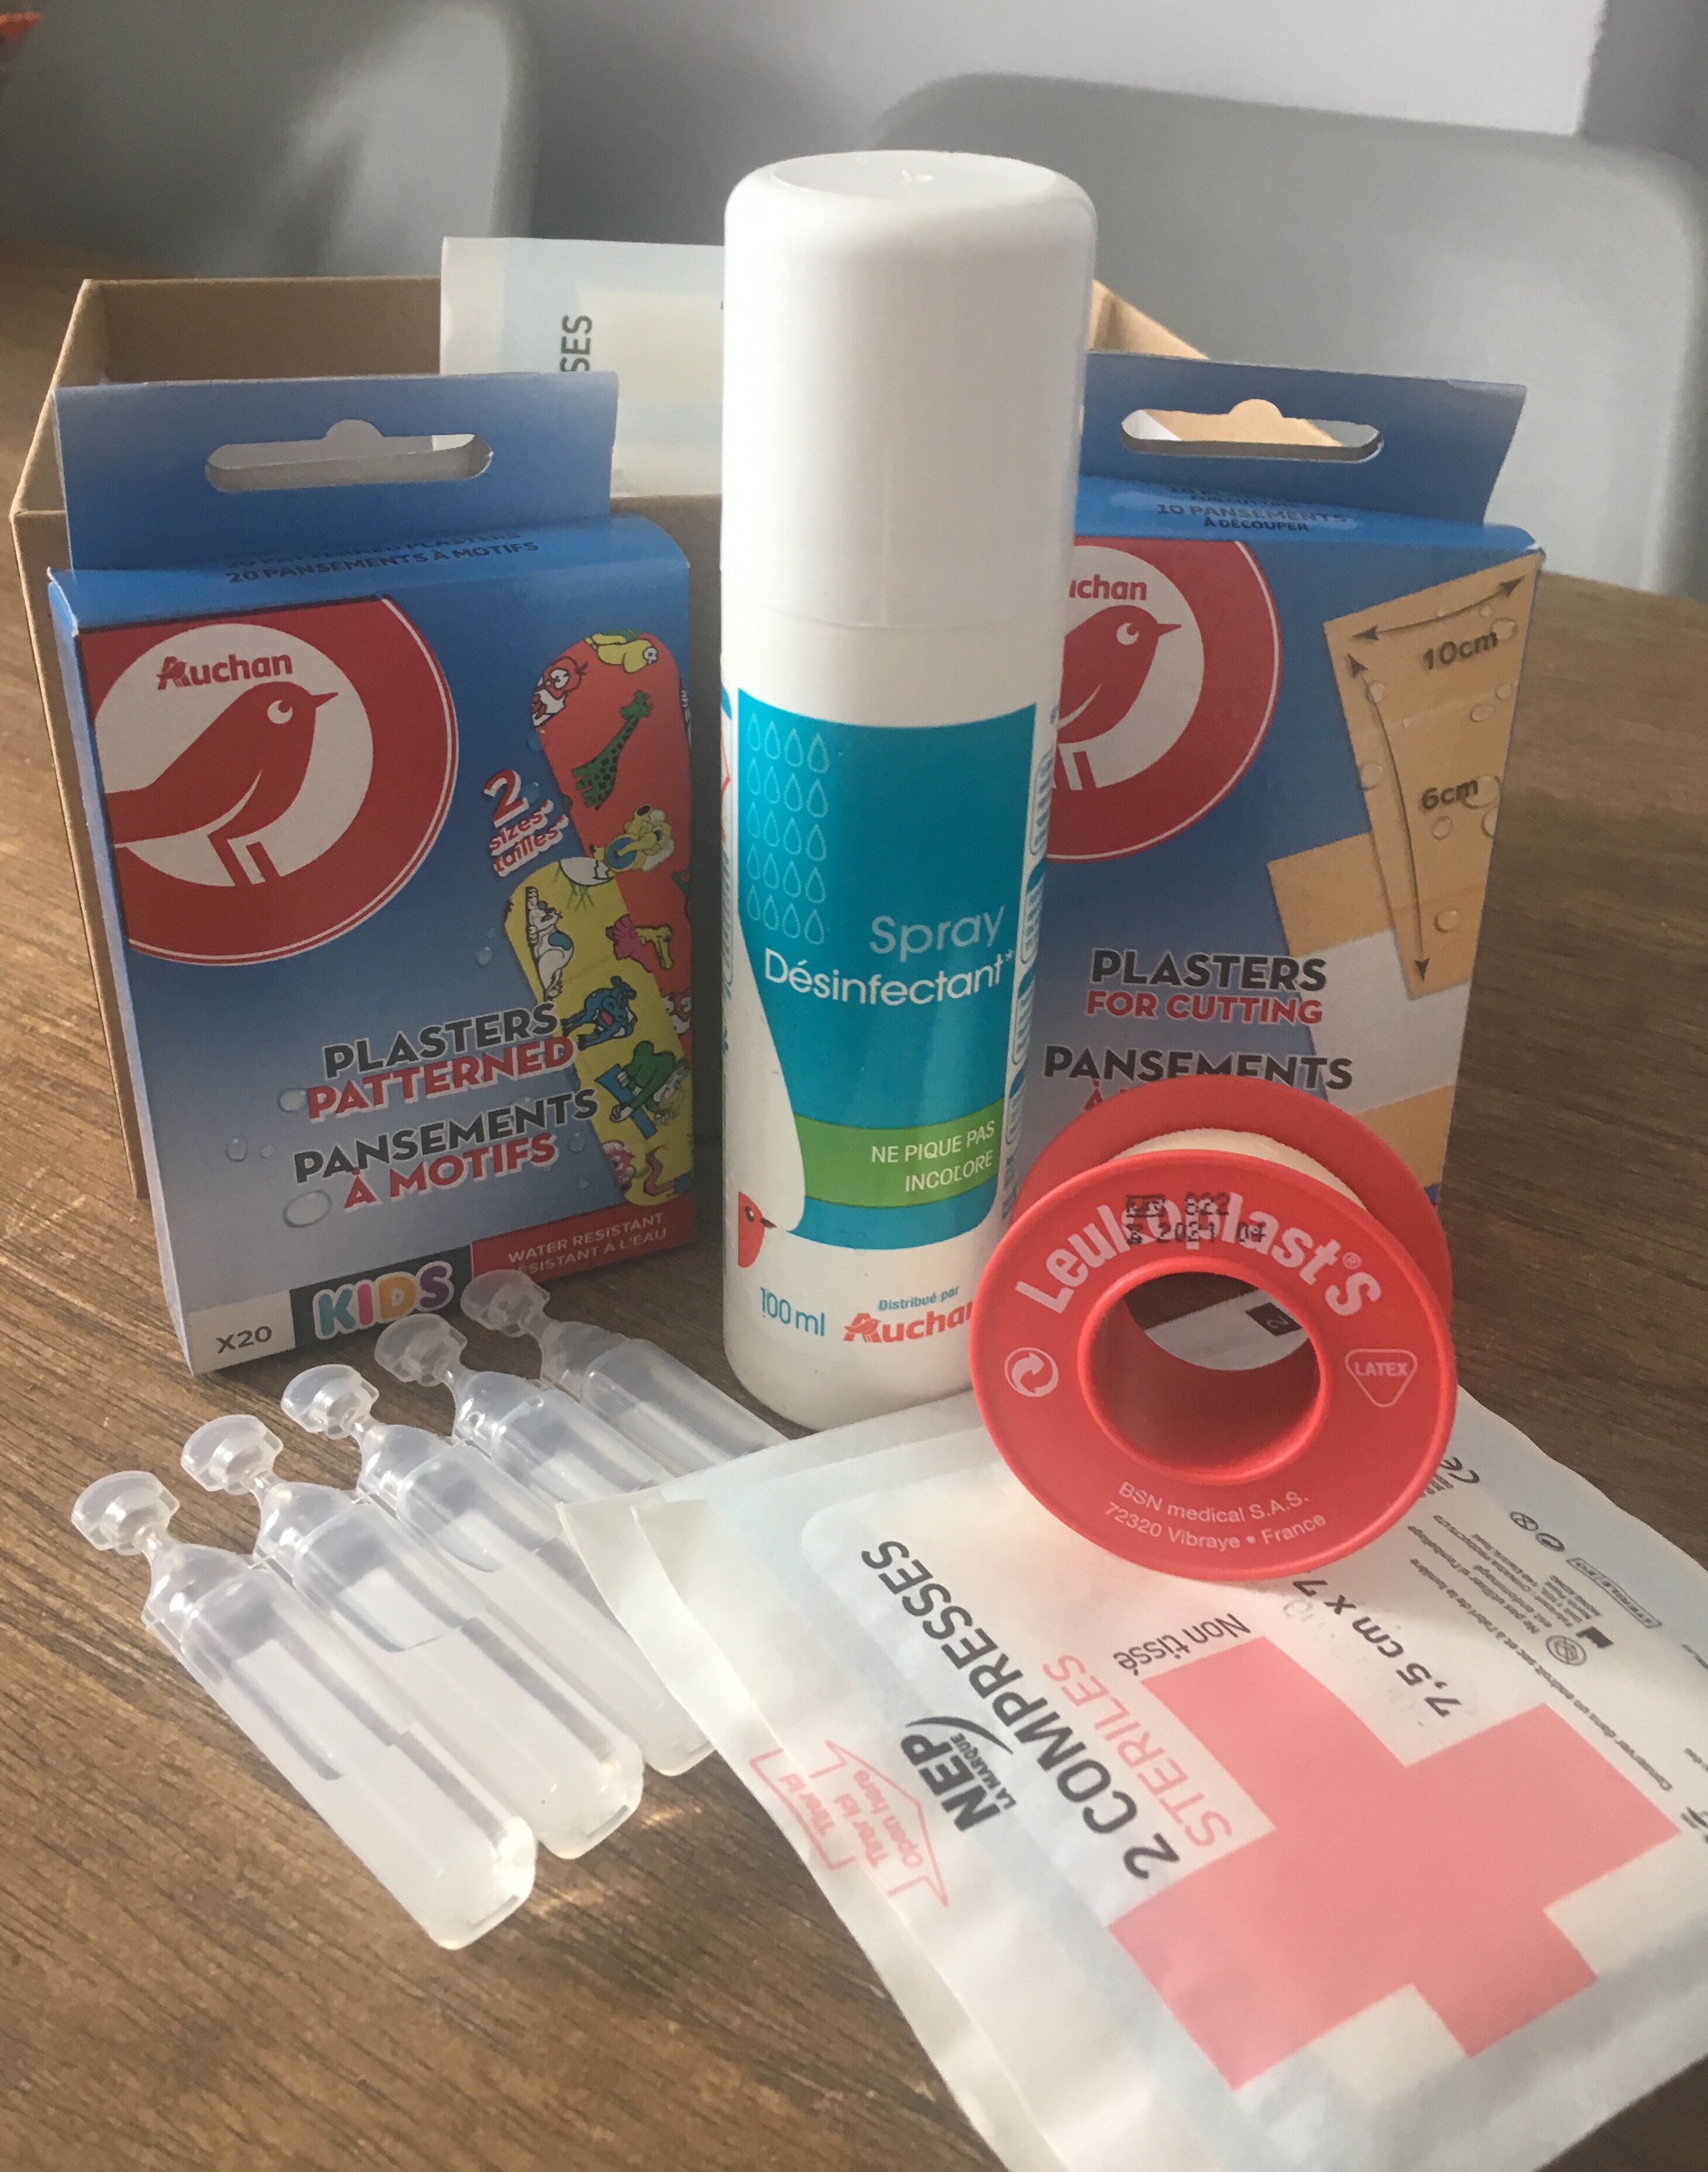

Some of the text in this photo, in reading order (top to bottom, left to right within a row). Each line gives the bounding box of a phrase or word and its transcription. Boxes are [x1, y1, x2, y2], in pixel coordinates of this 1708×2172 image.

[1157, 504, 1346, 522] 10 PANSEMENTS
[226, 571, 259, 583] 20
[263, 554, 428, 578] PANSEMENTS
[452, 542, 539, 558] MOTIFS
[1069, 574, 1147, 600] chan
[157, 654, 293, 690] Auchan
[1423, 631, 1498, 670] 10cm
[483, 768, 528, 828] 2
[1422, 779, 1479, 809] 6cm
[870, 906, 1005, 963] Spray
[1092, 949, 1327, 991] PLASTERS
[1087, 991, 1322, 1025] FOR CUTTING
[324, 1002, 558, 1079] PLASTERS
[307, 1036, 576, 1121] PATTERNED
[1044, 1045, 1353, 1090] PANSEMENTS
[294, 1089, 599, 1184] PANSEMENTS
[872, 1146, 898, 1163] NE
[905, 1135, 962, 1161] PIQUE
[967, 1120, 994, 1148] PAS
[344, 1132, 557, 1211] À MOTIFS
[905, 1150, 994, 1192] INCOLORE
[508, 1212, 664, 1263] WATER RESISTANT
[620, 1228, 667, 1250] L'EAU
[314, 1262, 453, 1340] KIDS
[878, 1286, 960, 1312] Distribué par
[1354, 1361, 1410, 1377] LATEX
[1118, 1481, 1309, 1523] BSN medical S.A.S.
[1104, 1501, 1327, 1552] 72320 Vibraye France
[1324, 1594, 1357, 1615] x
[1112, 1613, 1252, 1676] Non tissé
[1352, 1615, 1404, 1658] cm
[861, 1541, 1180, 1879] 2 COMPRESSES
[1396, 1662, 1462, 1717] 7,5
[950, 1733, 1017, 1810] LA MARQUE
[1042, 1654, 1232, 1848] STERILES
[901, 1734, 1001, 1832] NEP
